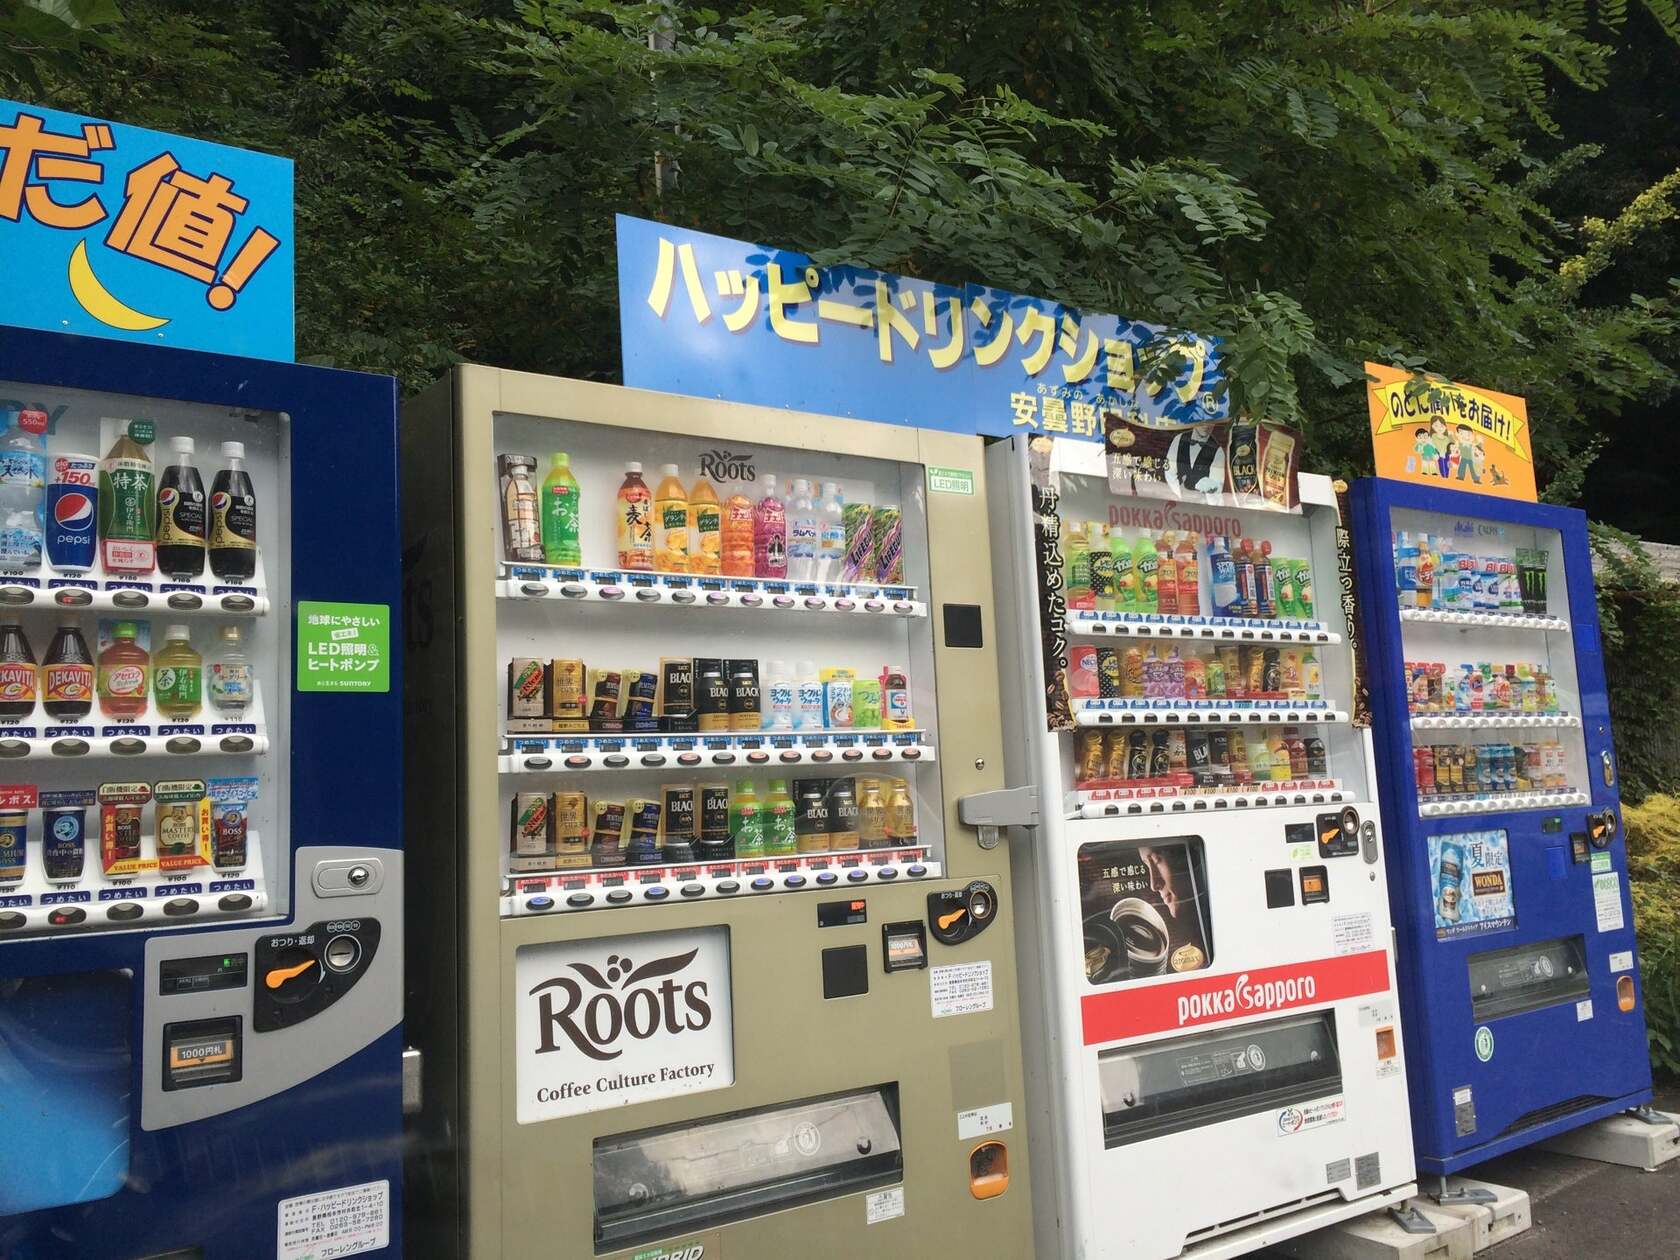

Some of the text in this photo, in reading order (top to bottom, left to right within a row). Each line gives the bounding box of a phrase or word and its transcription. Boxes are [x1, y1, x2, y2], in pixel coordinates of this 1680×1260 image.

[647, 236, 1206, 404] ハッピードリンクショップ
[698, 450, 756, 483] Roots
[114, 472, 148, 491] 特茶
[163, 508, 172, 541] pepsi
[216, 511, 225, 544] pepsi
[57, 535, 90, 545] pepsi
[308, 614, 380, 627] 地球にやさしい
[308, 658, 380, 672] ヒートポンプ
[49, 729, 91, 737] つめたい
[114, 863, 137, 871] VALUE
[1102, 864, 1146, 879] 五感で感じる
[214, 882, 251, 891] つめたい
[1112, 880, 1149, 894] 深い味わい
[1474, 873, 1503, 888] WONDA
[103, 890, 143, 899] つめたい
[160, 887, 198, 896] つめたい
[45, 895, 87, 904] つめたい
[270, 935, 315, 949] おつり・返却
[1243, 974, 1316, 1010] sapporo
[528, 976, 712, 1062] Roots
[181, 1044, 222, 1059] 1000円札
[537, 1063, 715, 1103] Coffee Culture Factory
[311, 1227, 326, 1235] FAX
[321, 1237, 376, 1257] フローレングループ
